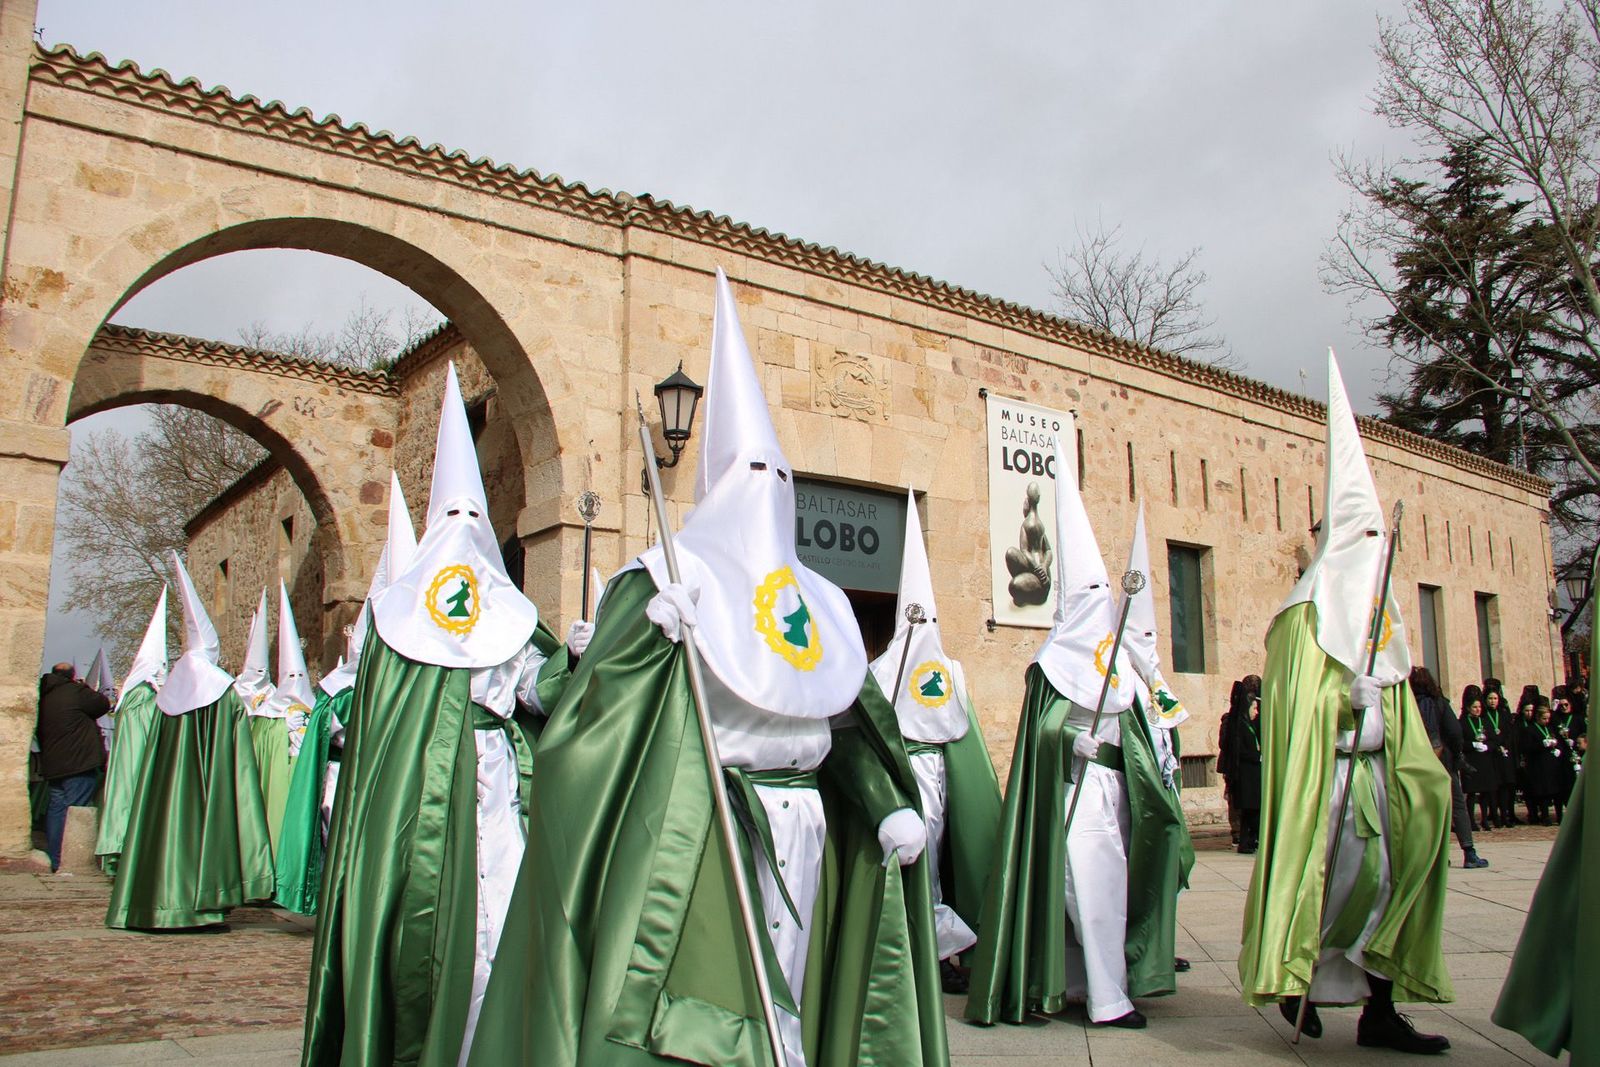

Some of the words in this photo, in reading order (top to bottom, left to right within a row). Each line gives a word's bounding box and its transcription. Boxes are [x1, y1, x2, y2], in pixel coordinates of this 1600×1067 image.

[1001, 409, 1060, 432] MUSEO
[1001, 425, 1056, 450] BALTASA
[796, 492, 878, 520] BALTASAR
[797, 516, 880, 555] LOBO
[797, 553, 831, 565] CASTILLO
